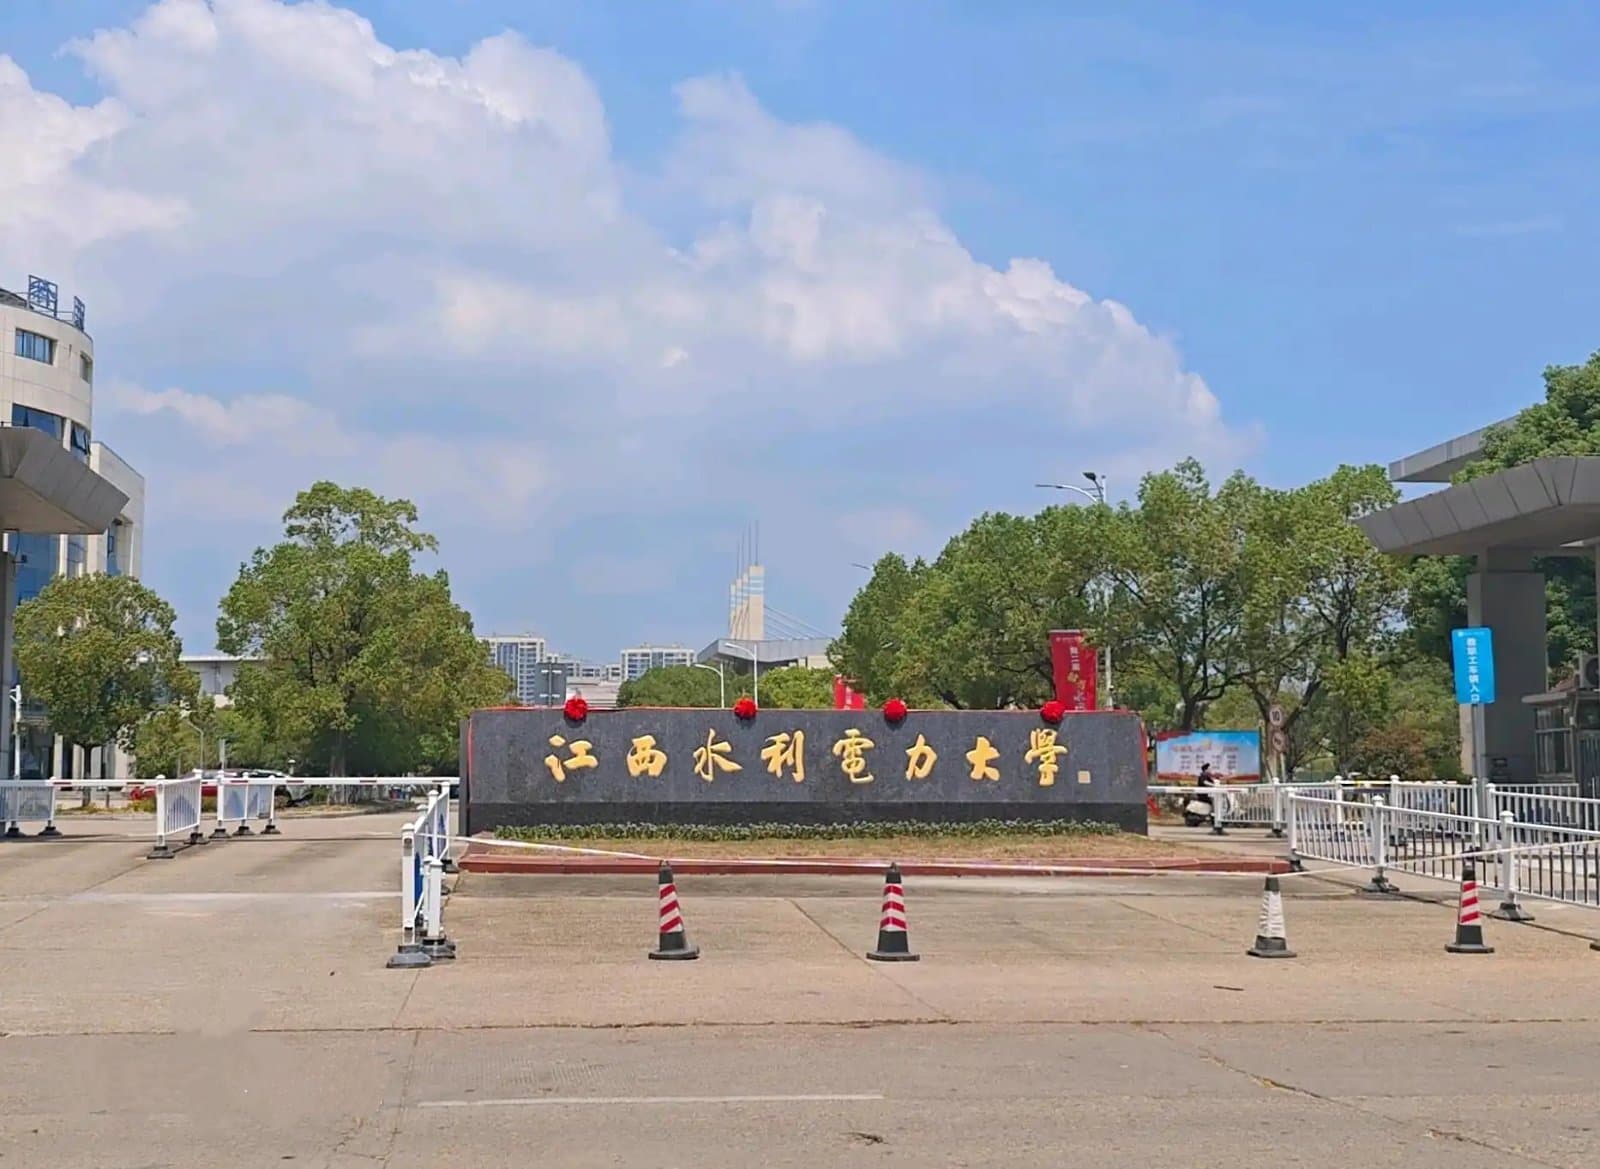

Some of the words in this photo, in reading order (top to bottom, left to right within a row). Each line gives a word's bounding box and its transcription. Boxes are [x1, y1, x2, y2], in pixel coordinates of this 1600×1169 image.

[544, 729, 1068, 786] 江西水利電力大學
